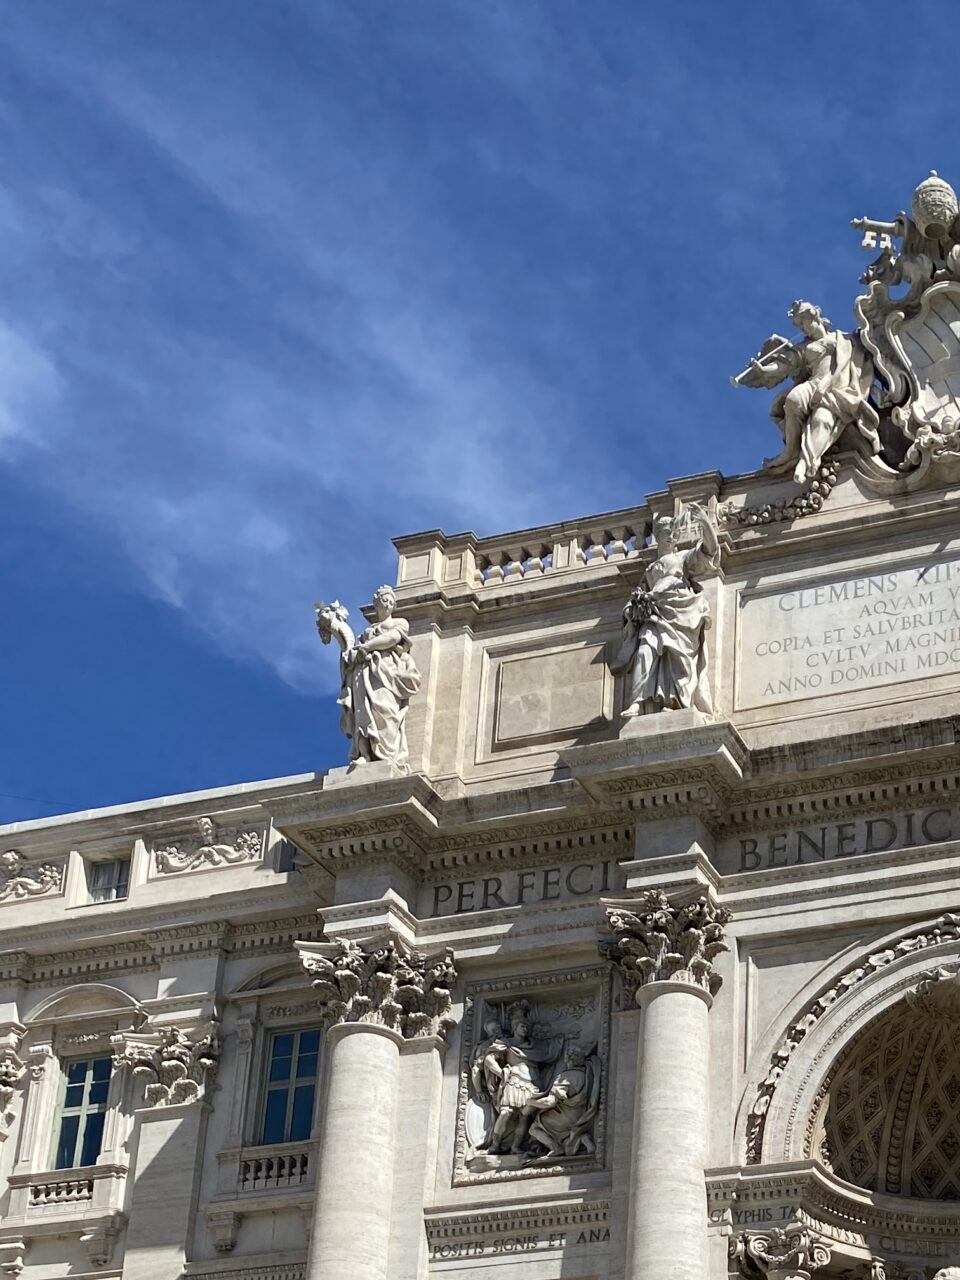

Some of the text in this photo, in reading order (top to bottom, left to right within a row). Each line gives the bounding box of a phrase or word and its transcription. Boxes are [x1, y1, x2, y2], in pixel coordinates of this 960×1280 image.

[779, 574, 898, 612] CLEMENS
[858, 591, 935, 618] AQVAM
[755, 635, 814, 656] COPIA
[823, 628, 845, 645] ET
[806, 644, 872, 667] CVLTV
[762, 673, 822, 696] ANNO
[830, 658, 905, 685] DOMINI
[430, 859, 621, 917] PERFECI
[432, 1241, 485, 1259] POSITIS
[492, 1235, 539, 1253] SIGNIS
[548, 1232, 567, 1247] ET
